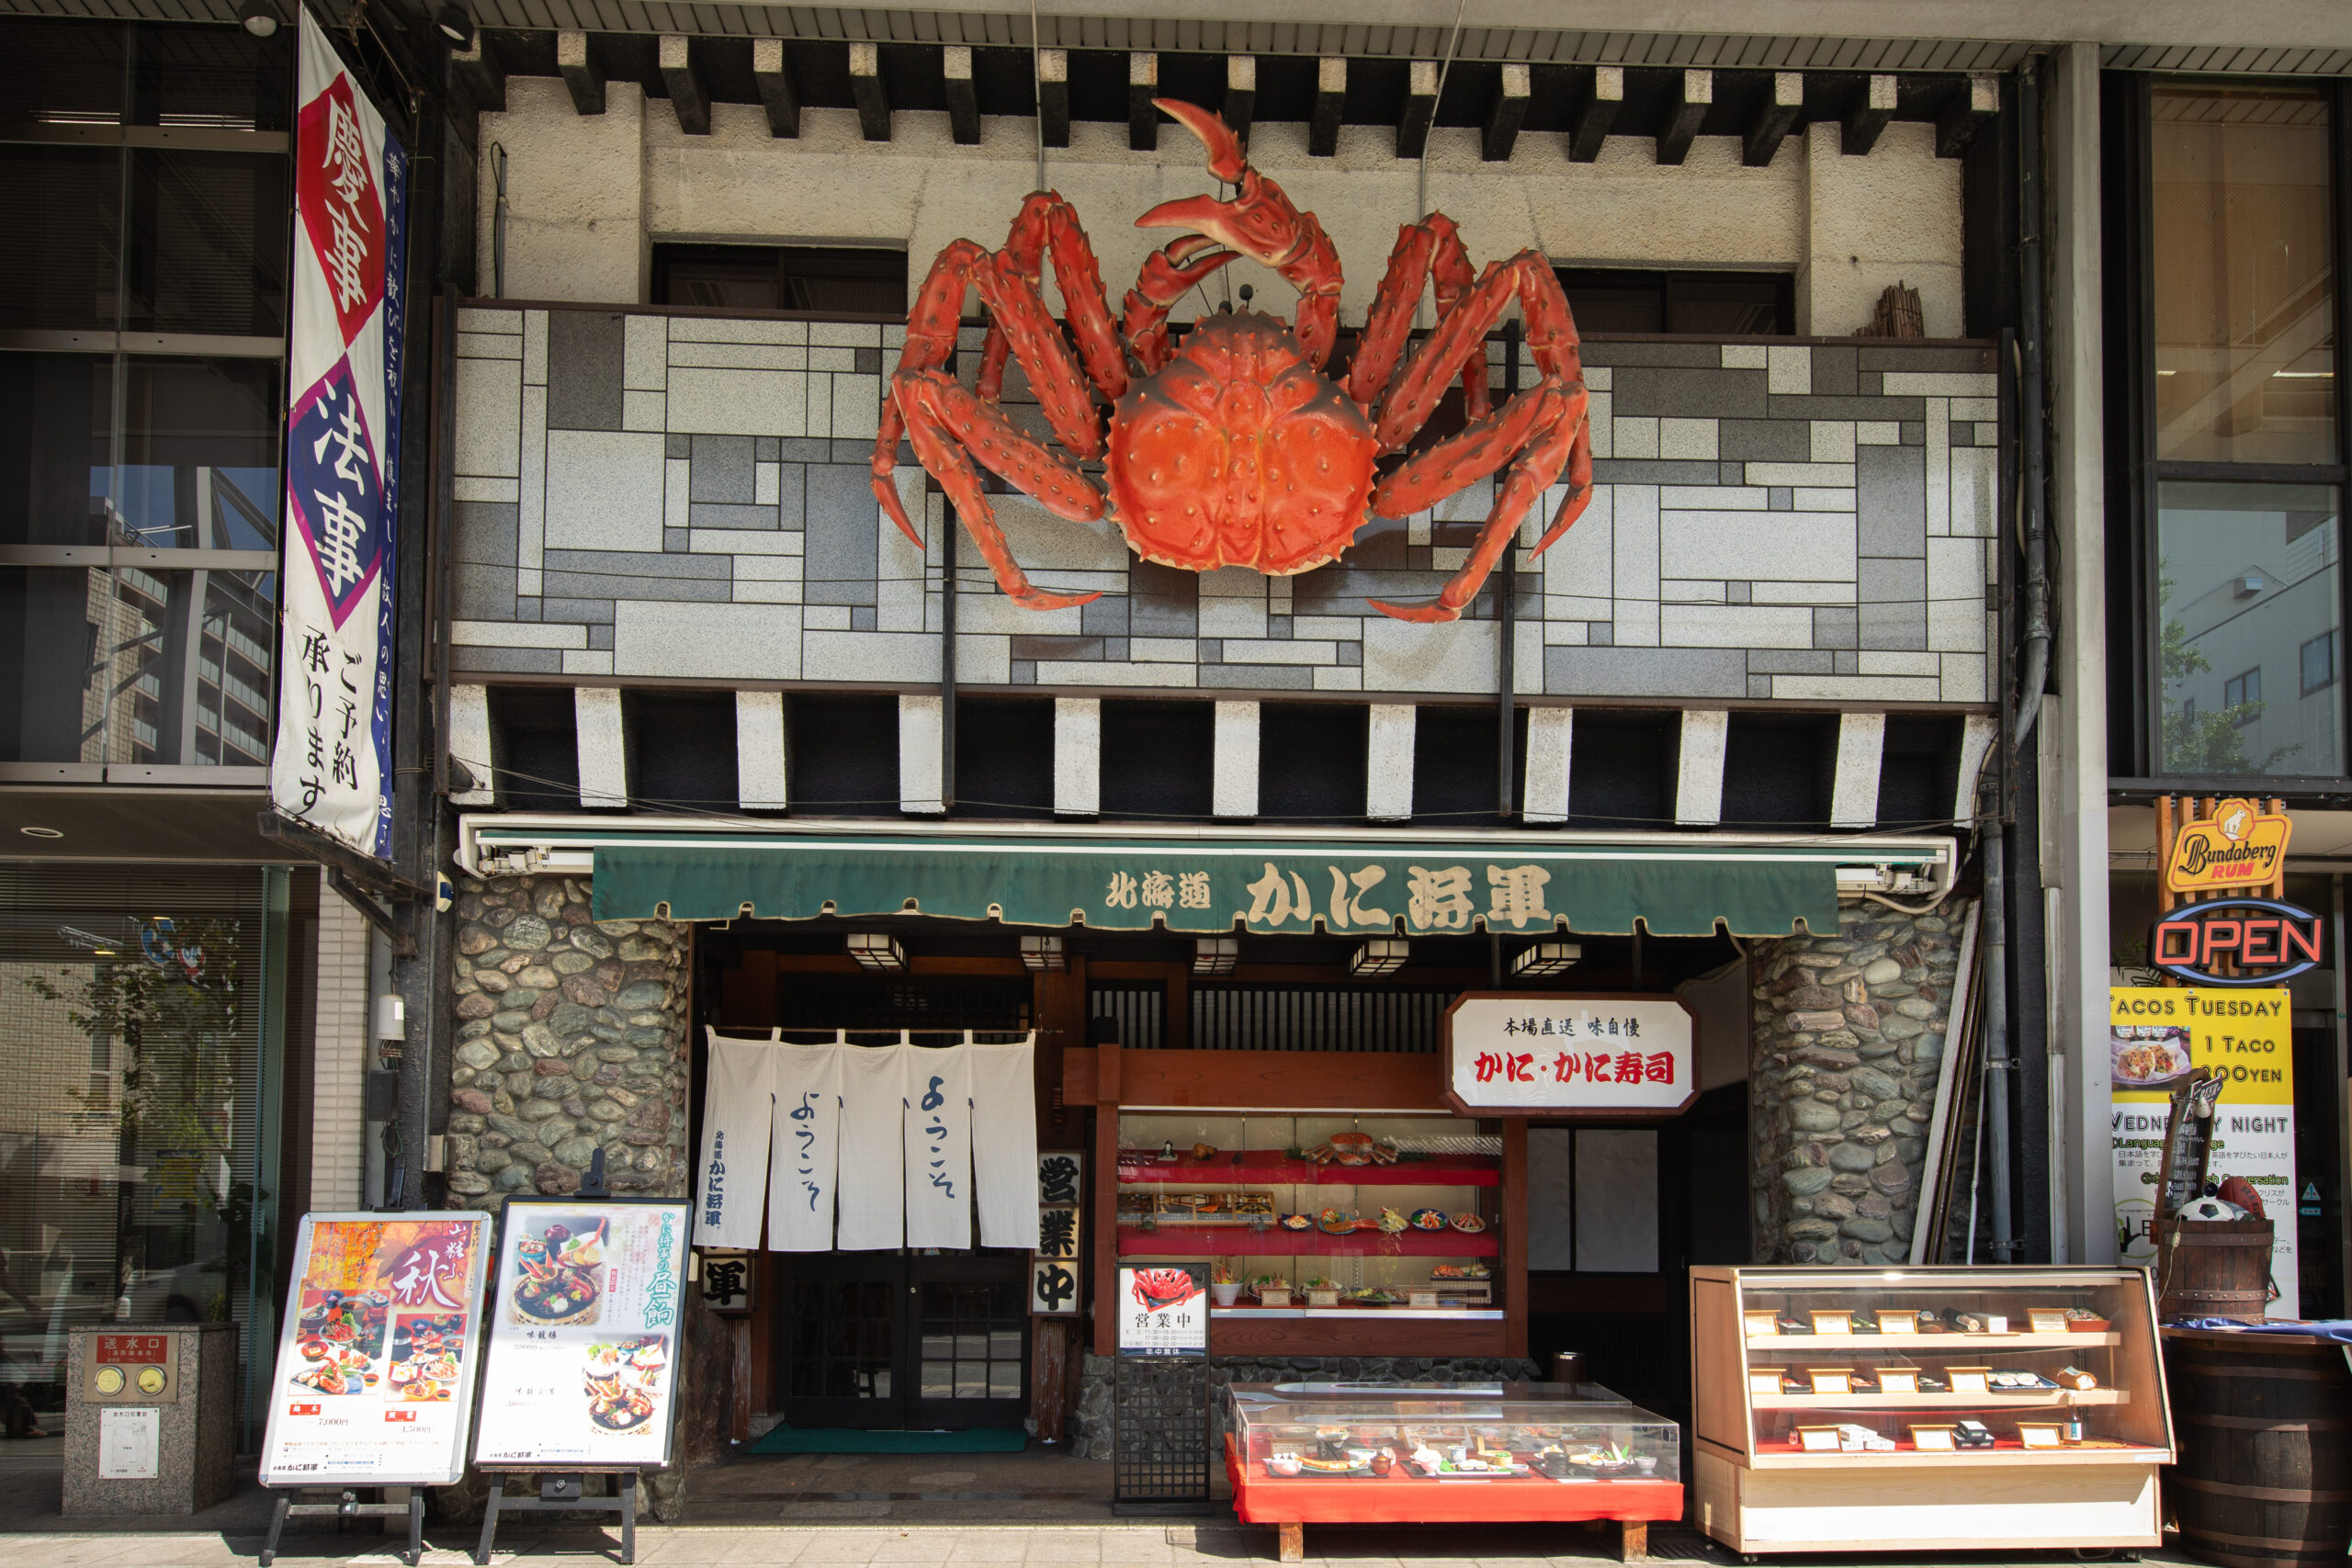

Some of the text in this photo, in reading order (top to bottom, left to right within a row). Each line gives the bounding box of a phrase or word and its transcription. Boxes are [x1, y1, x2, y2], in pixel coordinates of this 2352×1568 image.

[322, 94, 369, 315] 慶事
[312, 377, 369, 600] 法事
[299, 625, 332, 816] 承ります
[332, 649, 362, 792] ご予約
[2178, 833, 2277, 876] Bundaberg
[2211, 862, 2255, 879] RUM
[1105, 861, 1553, 930] 北海道 かに将軍
[2154, 919, 2322, 965] OPEN
[2110, 995, 2176, 1015] ACOS
[1503, 1017, 1641, 1038] 本場直送 味自慢
[2205, 1035, 2213, 1053] 1
[1474, 1050, 1675, 1086] かに・かに寿司
[2200, 1065, 2283, 1083] 00YEN
[921, 1075, 956, 1200] ようこそ
[2231, 1115, 2289, 1133] NIGHT
[790, 1091, 820, 1213] ようこそ
[705, 1159, 726, 1227] かに将軍
[1038, 1156, 1079, 1312] 営業中
[393, 1249, 461, 1309] 秋
[1135, 1313, 1191, 1328] 営業中
[104, 1337, 160, 1349] 送水口
[1146, 1348, 1181, 1356] 年中無休
